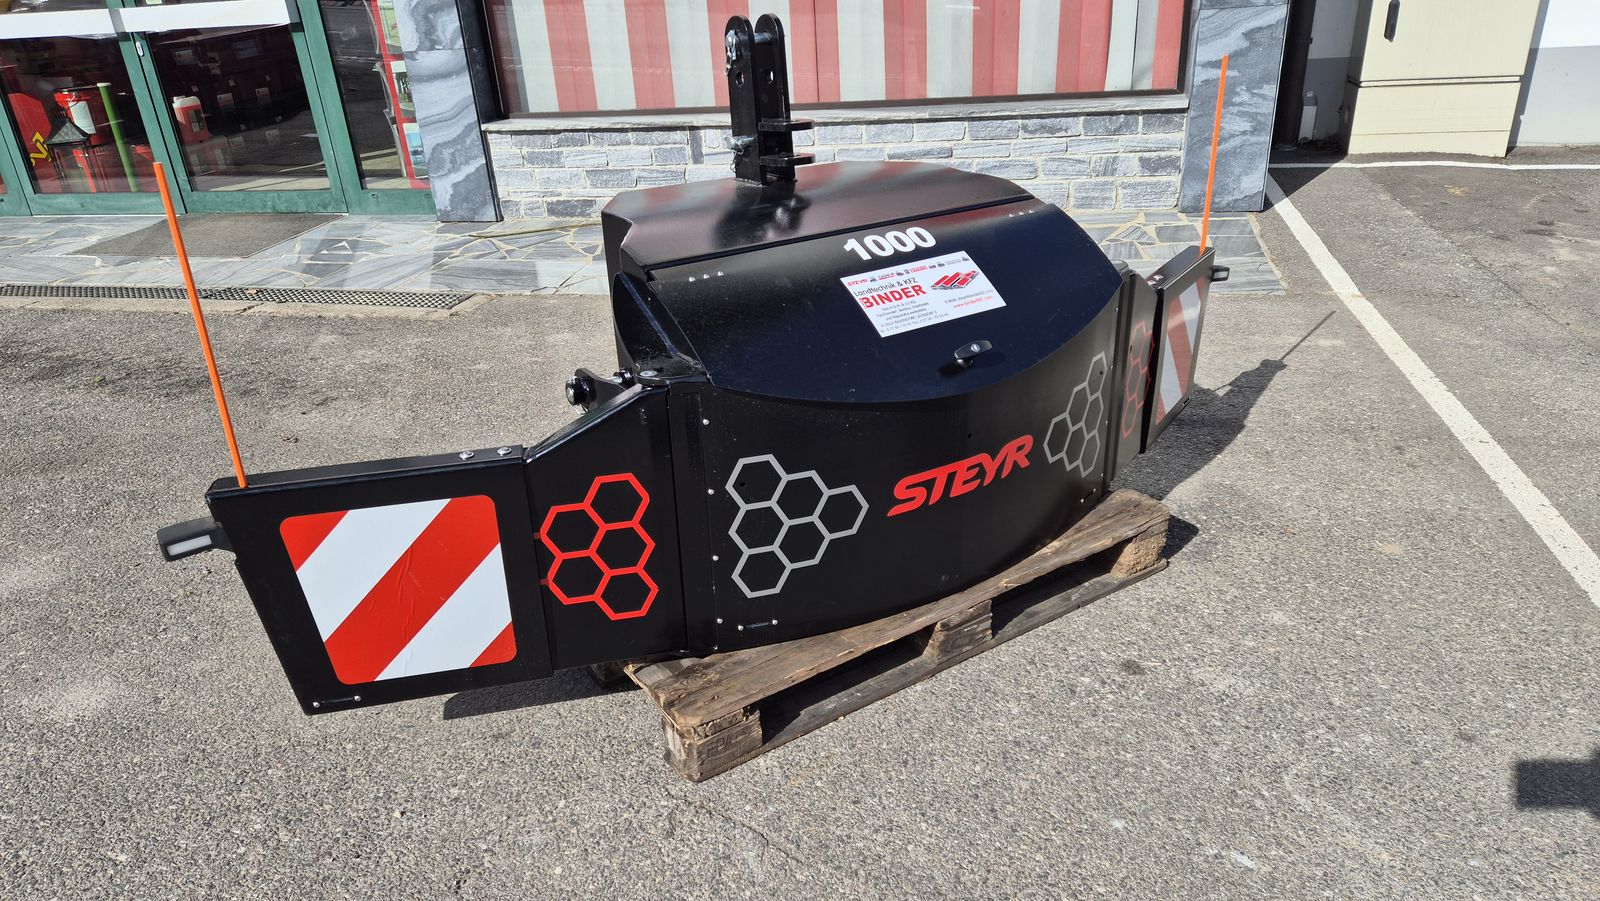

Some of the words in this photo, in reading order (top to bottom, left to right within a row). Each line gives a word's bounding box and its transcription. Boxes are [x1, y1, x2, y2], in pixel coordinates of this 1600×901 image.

[843, 227, 936, 260] 1000
[853, 282, 897, 297] Landtechnik
[903, 277, 918, 285] KFZ
[861, 284, 927, 308] BINDER
[886, 434, 1034, 517] STEYR
